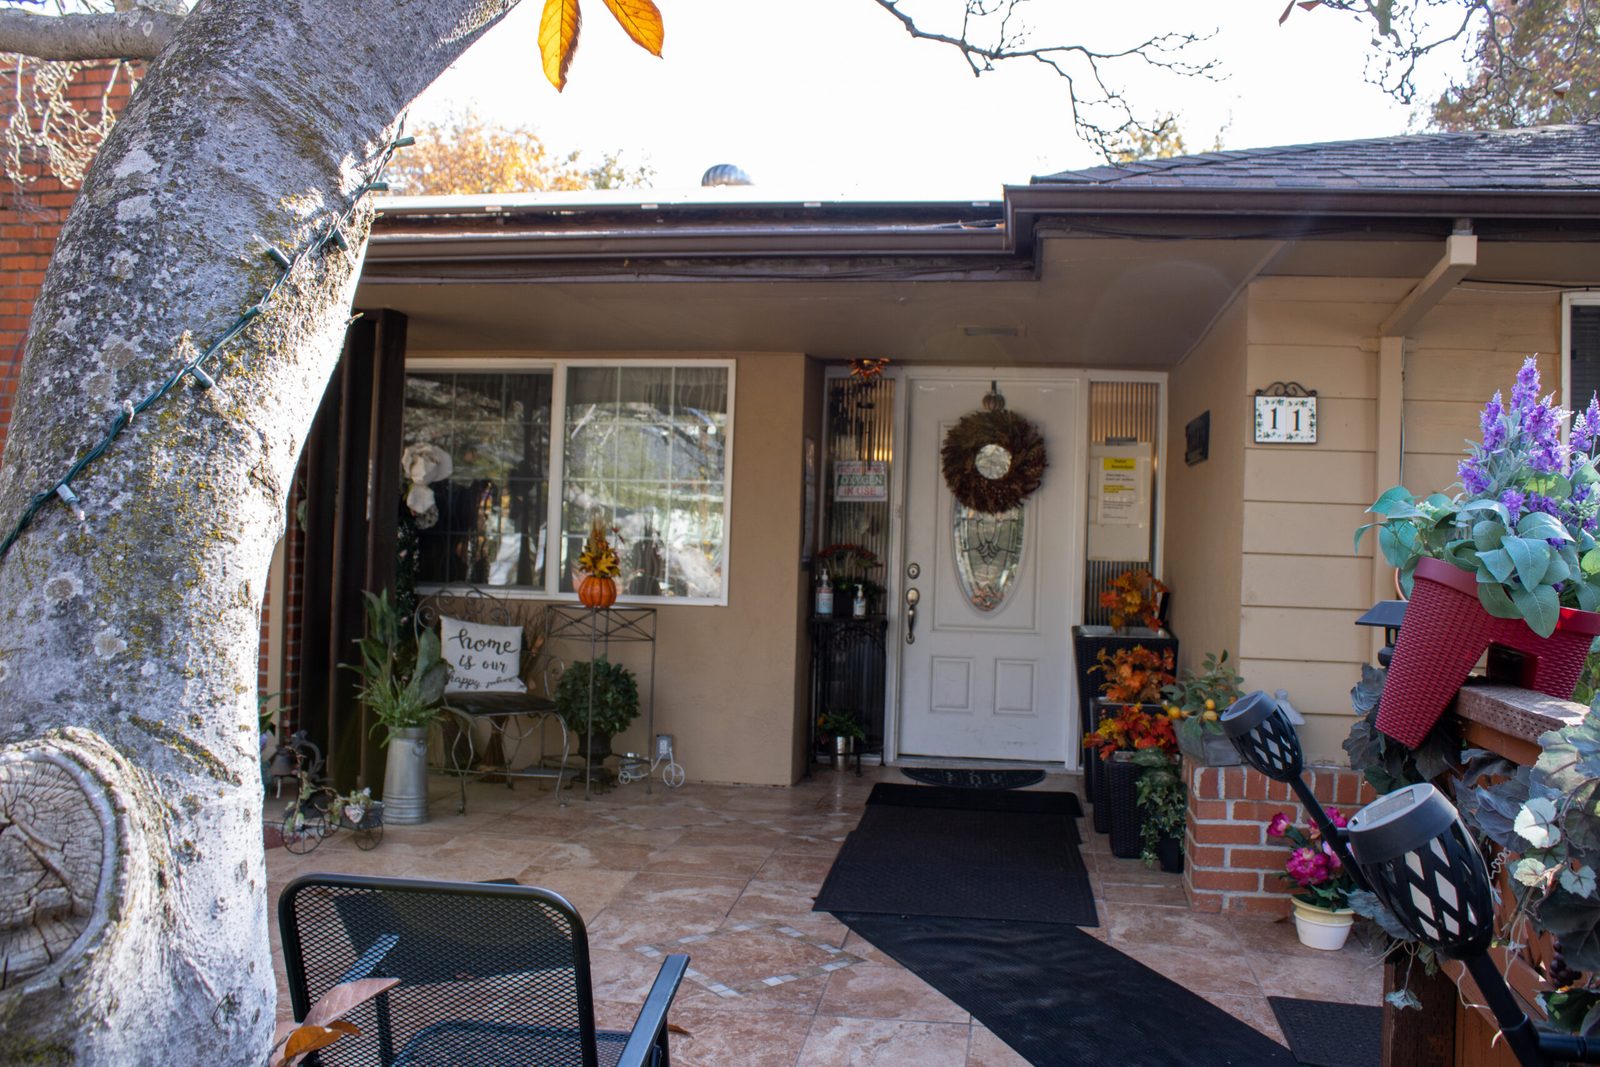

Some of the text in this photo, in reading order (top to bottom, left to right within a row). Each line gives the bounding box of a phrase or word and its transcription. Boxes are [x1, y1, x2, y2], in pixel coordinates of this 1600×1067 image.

[1271, 407, 1300, 431] 11
[840, 475, 883, 486] OXYGEN
[843, 486, 877, 496] IN USE
[448, 628, 519, 655] home
[459, 654, 506, 673] is our
